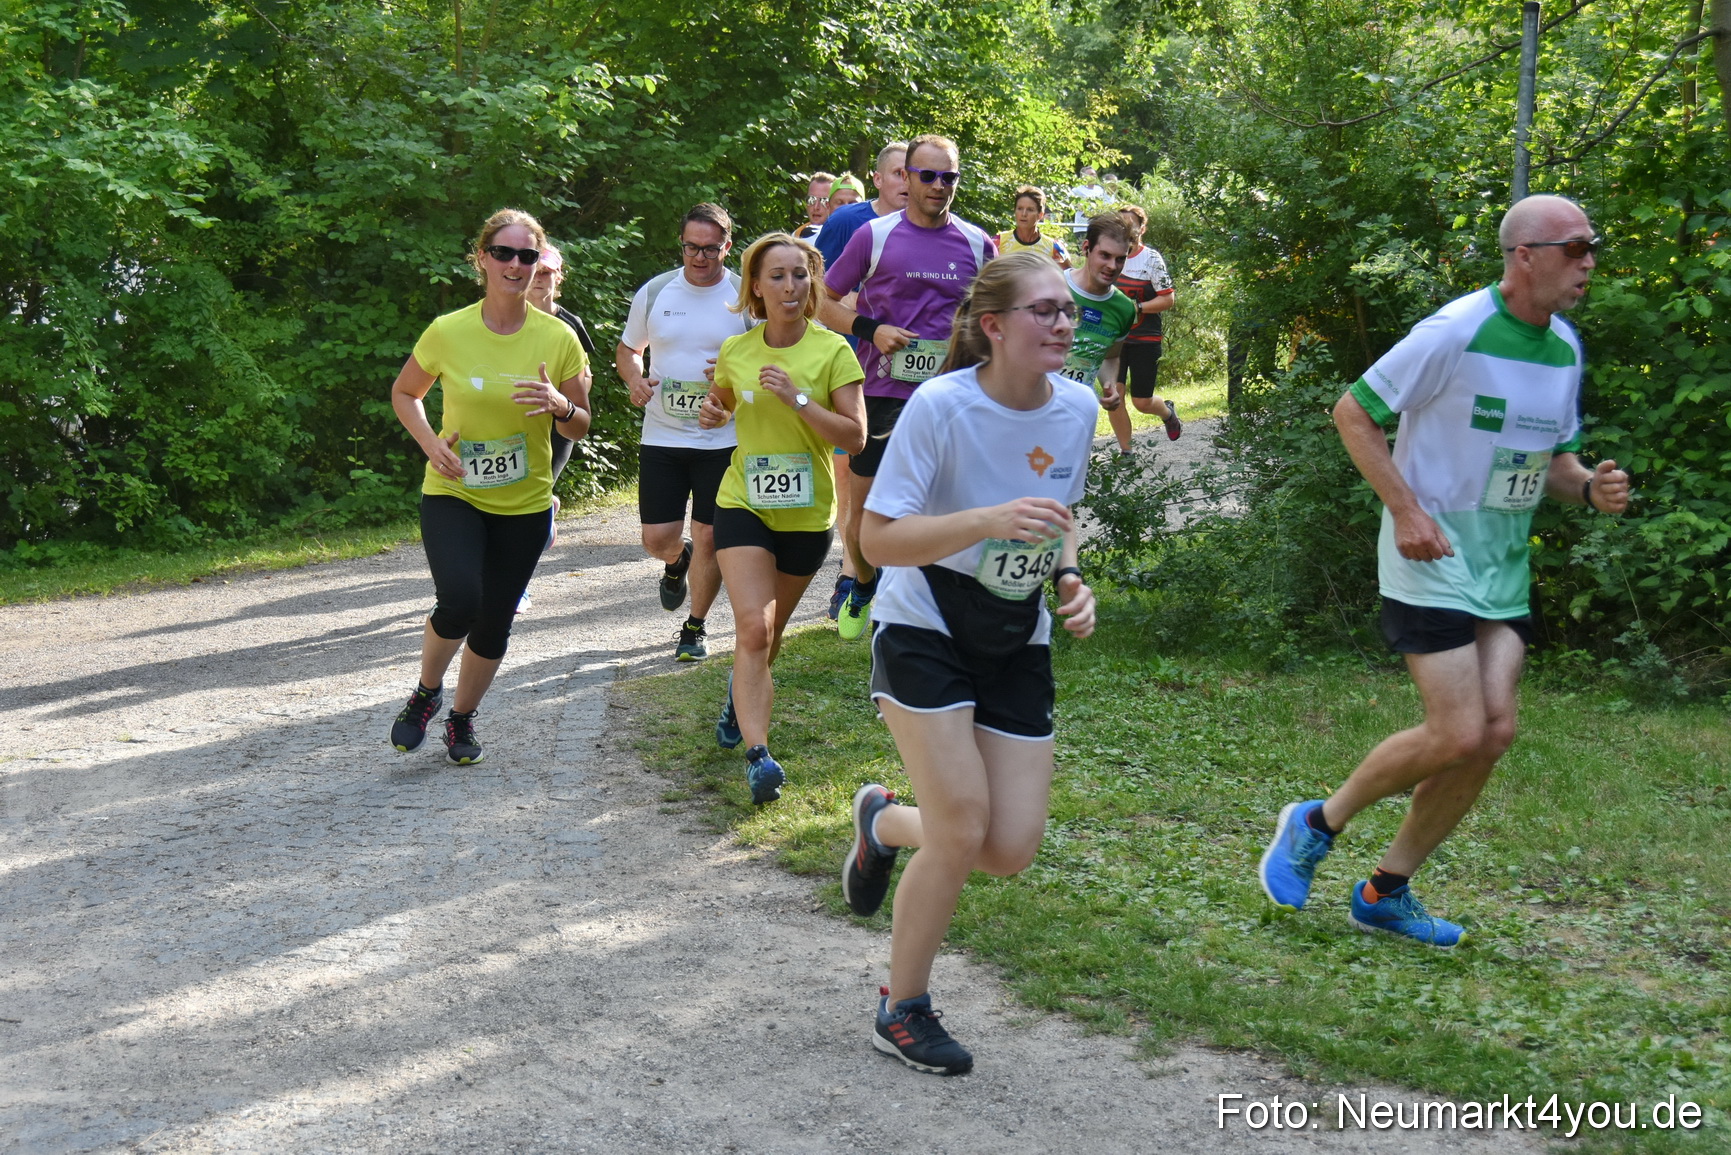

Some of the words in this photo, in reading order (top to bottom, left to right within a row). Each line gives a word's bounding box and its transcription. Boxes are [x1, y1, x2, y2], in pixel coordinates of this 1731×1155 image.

[904, 354, 936, 371] 900
[1473, 406, 1505, 420] BayWa
[469, 452, 518, 476] 1281
[752, 472, 801, 494] 1291
[1506, 472, 1540, 496] 115
[994, 551, 1054, 580] 1348
